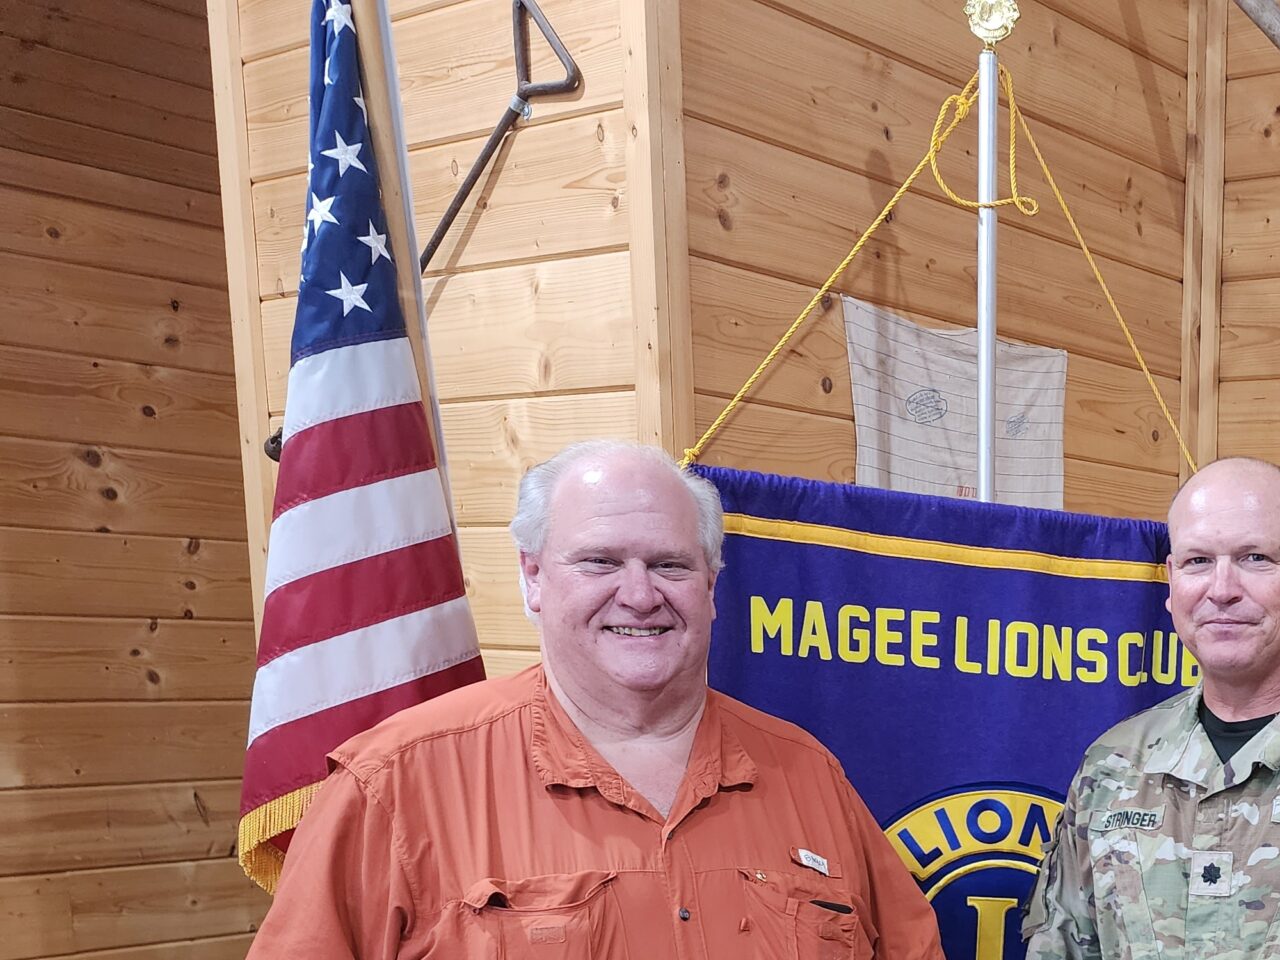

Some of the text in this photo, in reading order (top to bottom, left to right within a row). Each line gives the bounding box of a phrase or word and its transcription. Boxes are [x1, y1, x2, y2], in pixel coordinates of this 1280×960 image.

[749, 595, 942, 669] MAGEE
[953, 615, 1108, 683] LIONS
[1104, 811, 1157, 829] STRINGER
